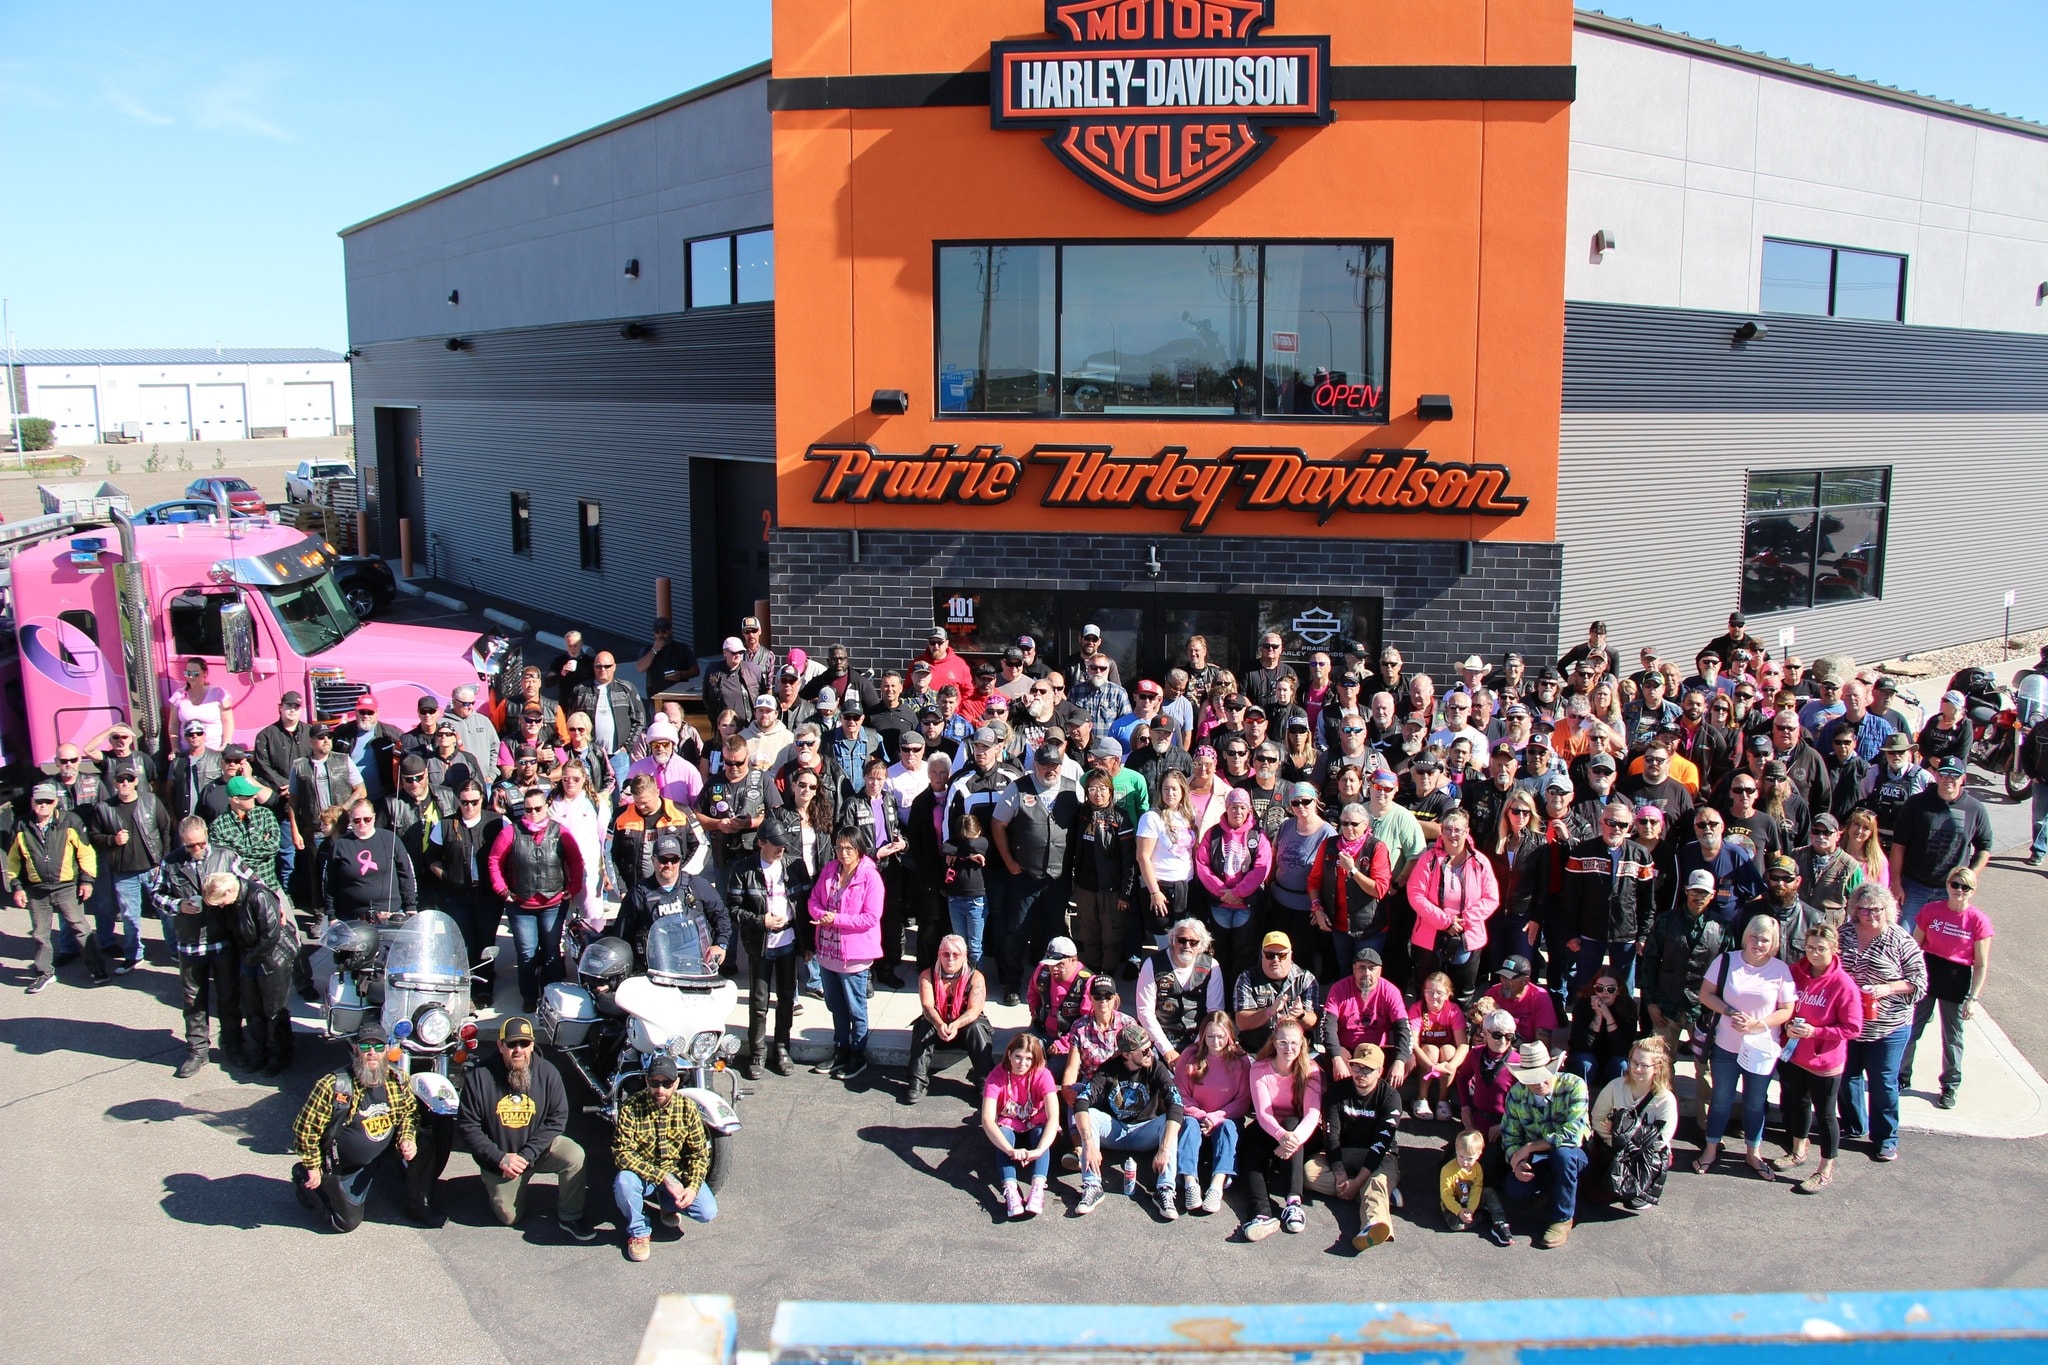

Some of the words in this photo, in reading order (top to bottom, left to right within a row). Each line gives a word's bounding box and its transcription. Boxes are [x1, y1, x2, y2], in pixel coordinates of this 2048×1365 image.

[1087, 0, 1232, 41] MOTOR
[1021, 56, 1298, 108] HARLEY-DAVIDSON
[1085, 124, 1231, 189] CYCLES
[1316, 384, 1382, 408] OPEN
[811, 447, 1015, 499] Prairie
[948, 597, 973, 617] 101
[658, 900, 683, 917] POLICE
[502, 1112, 529, 1121] RMAI
